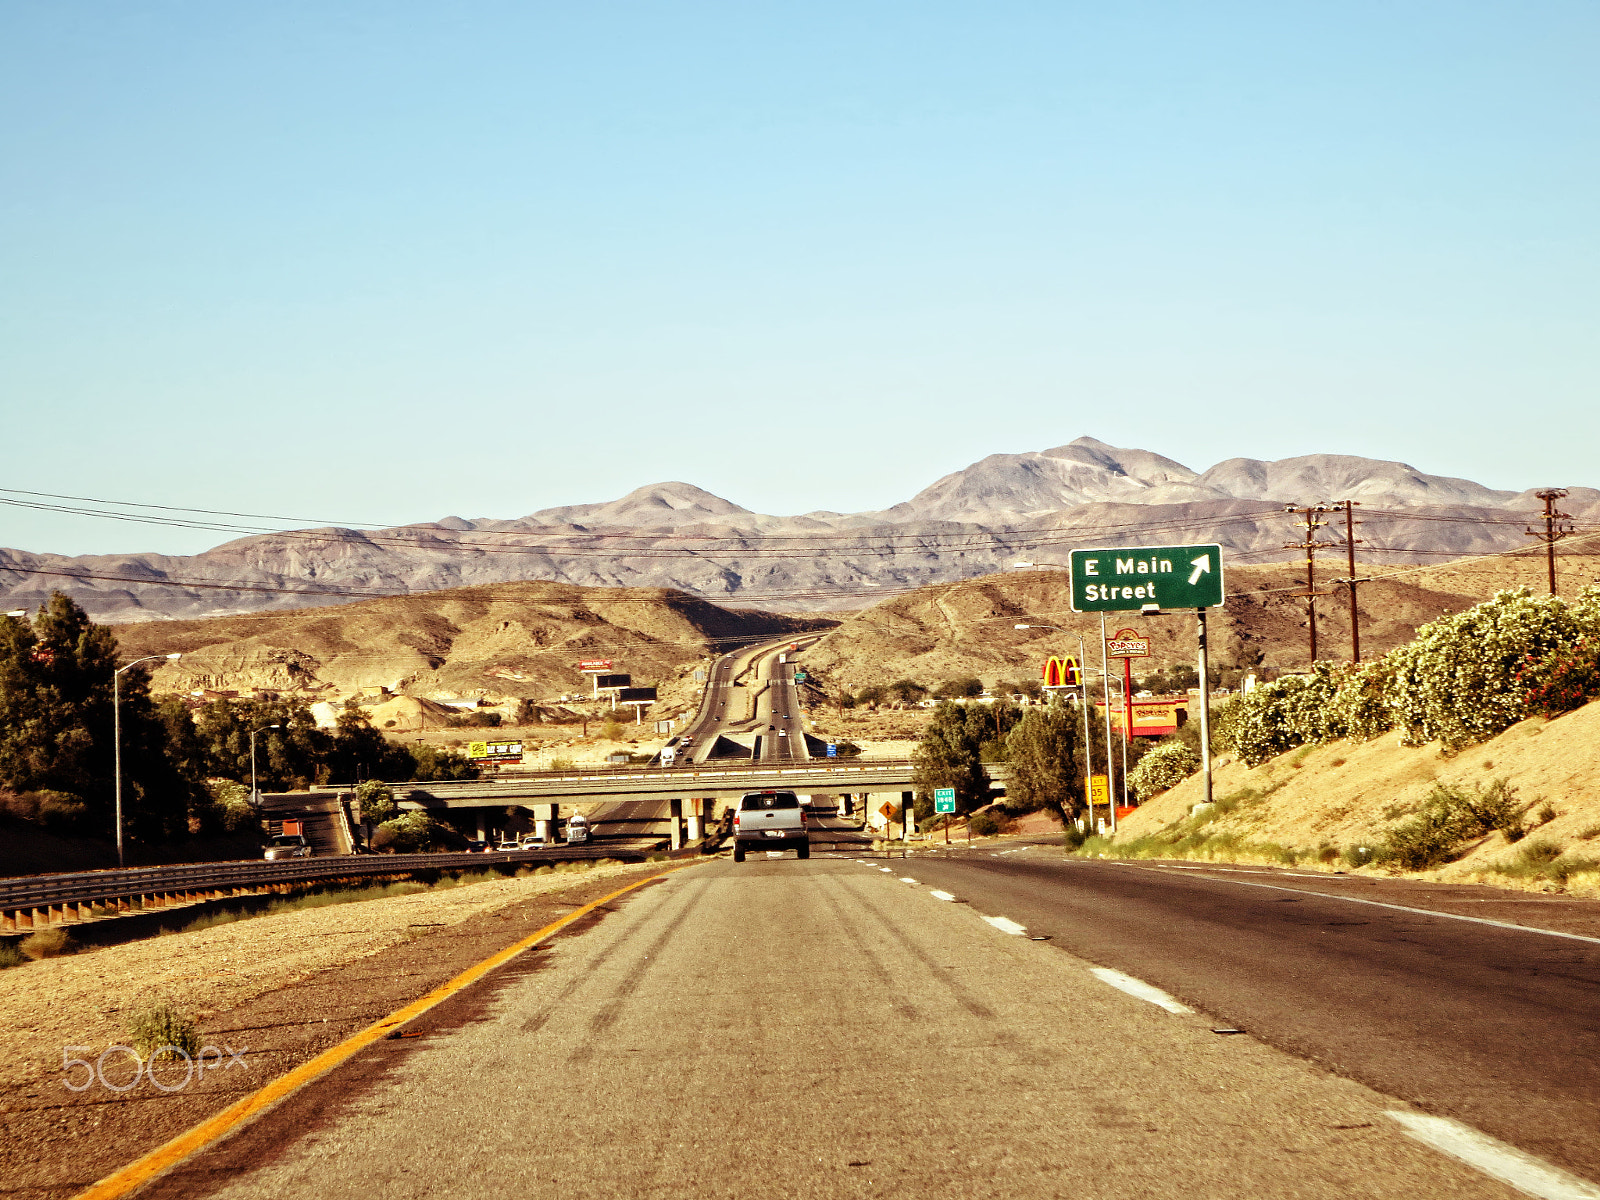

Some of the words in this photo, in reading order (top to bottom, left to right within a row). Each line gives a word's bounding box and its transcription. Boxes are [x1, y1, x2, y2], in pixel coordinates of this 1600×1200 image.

[1085, 559, 1099, 576] E
[1116, 557, 1173, 575] Main
[1085, 581, 1156, 602] Street
